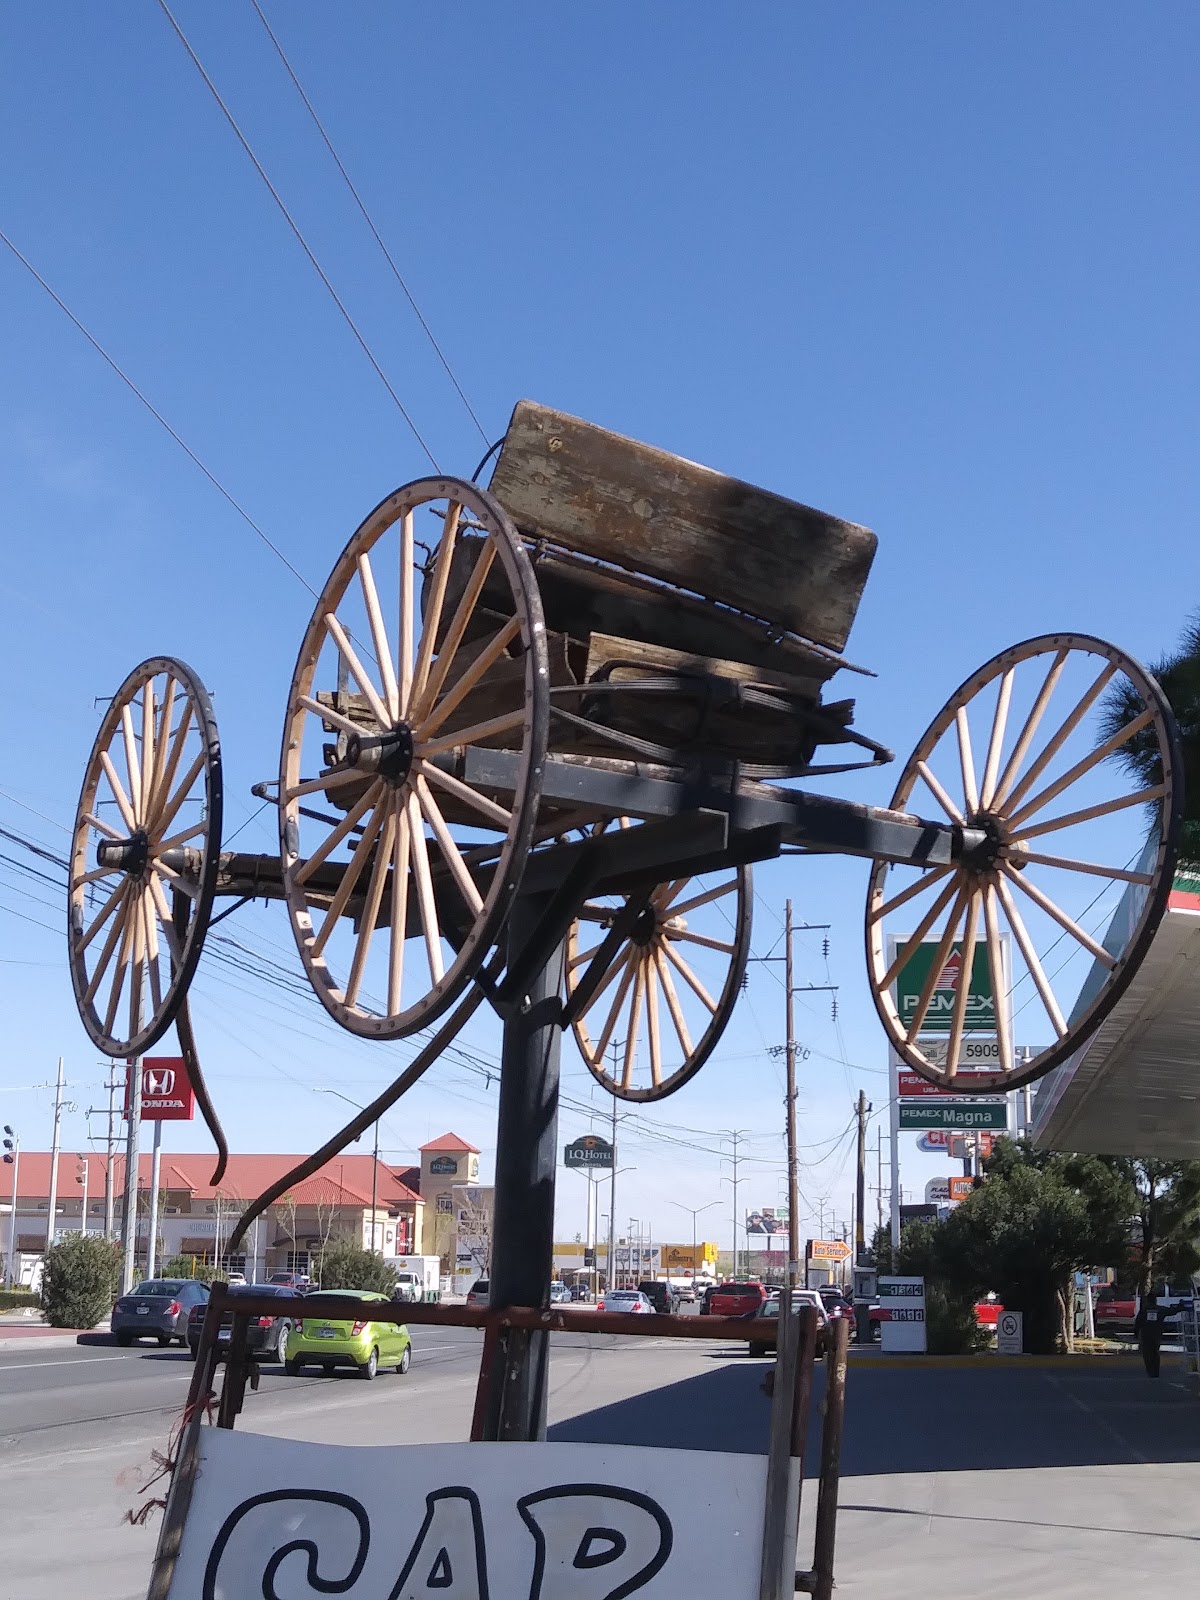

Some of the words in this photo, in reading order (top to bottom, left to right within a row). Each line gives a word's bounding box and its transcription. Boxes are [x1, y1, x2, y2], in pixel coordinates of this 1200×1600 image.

[966, 1044, 1000, 1057] 5909
[141, 1099, 185, 1108] ONDA
[901, 1109, 942, 1118] PEMEX
[943, 1109, 993, 1125] Magna
